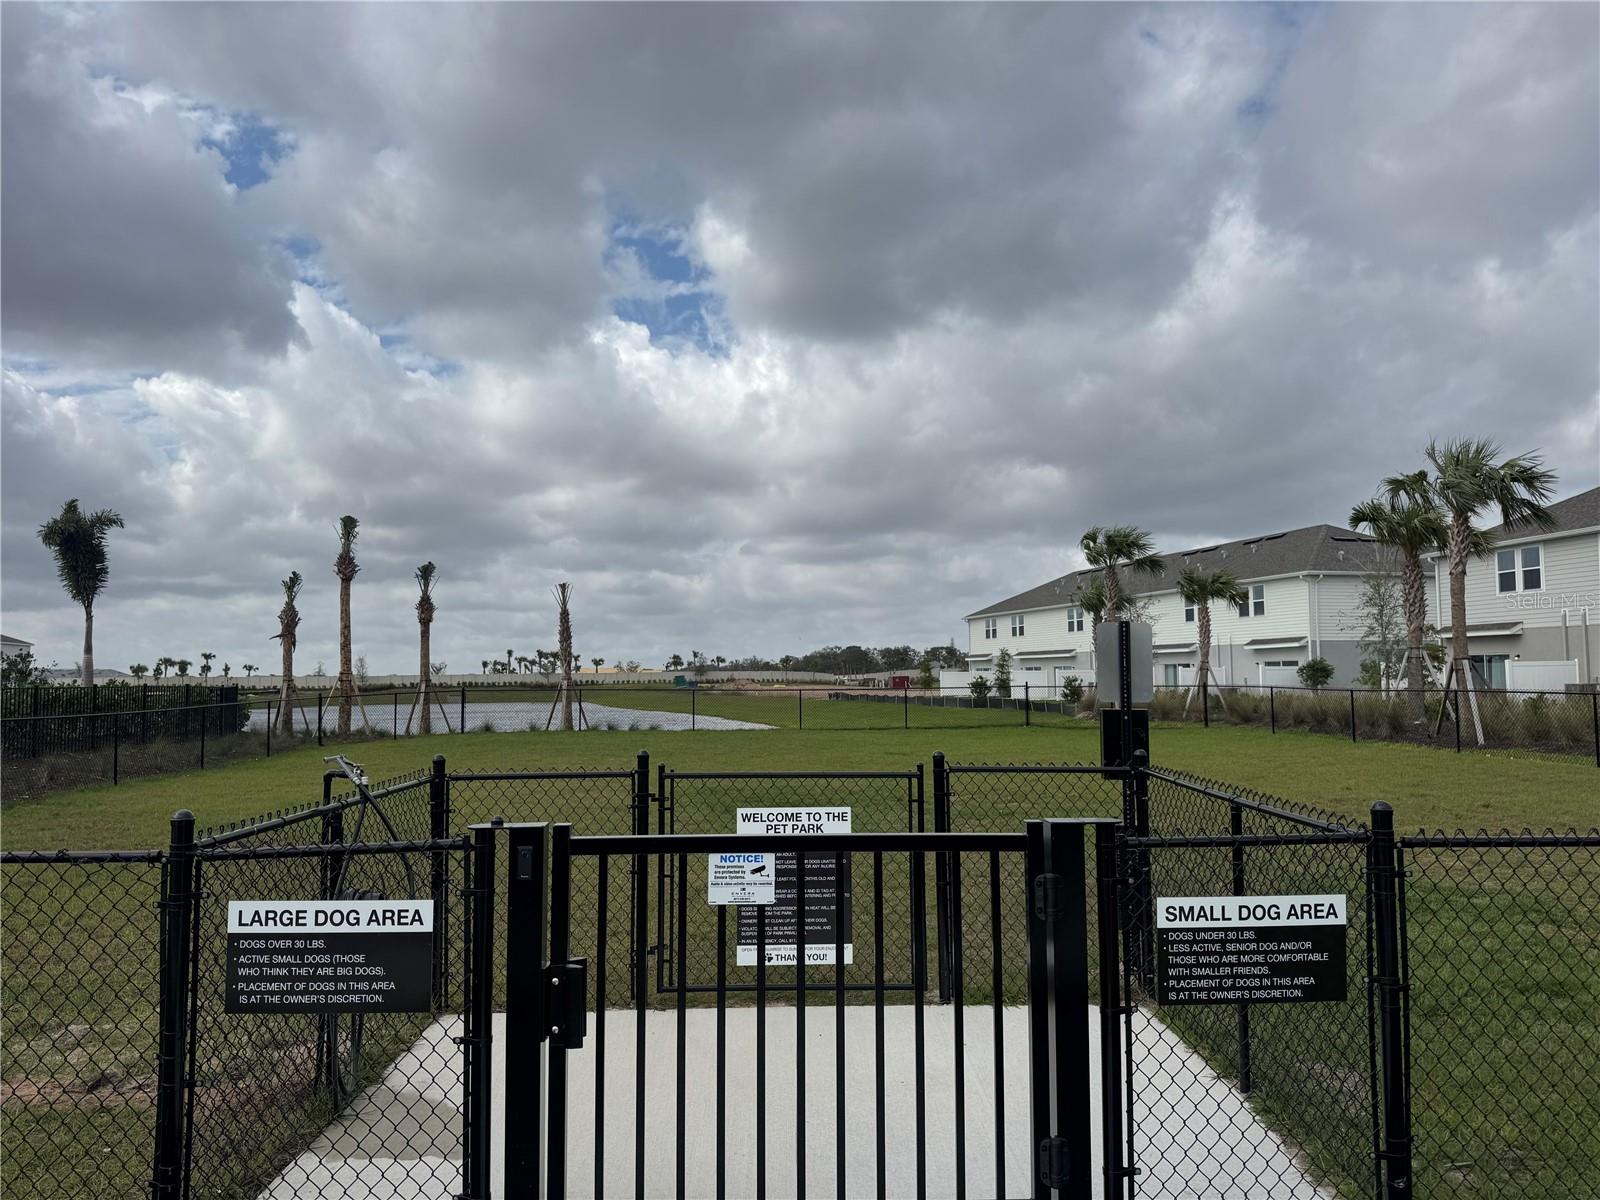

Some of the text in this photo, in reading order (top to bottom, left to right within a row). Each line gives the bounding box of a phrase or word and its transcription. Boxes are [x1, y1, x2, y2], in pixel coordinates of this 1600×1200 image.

[741, 812, 848, 823] WELCOME TO THE
[766, 824, 824, 834] PET PARK
[238, 909, 424, 926] LARGE DOG AREA
[1165, 903, 1338, 922] SMALL DOG AREA
[1169, 932, 1193, 940] DOGS
[1196, 932, 1225, 940] UNDER
[240, 940, 326, 948] DOGS OVER 30 LBS.
[1169, 944, 1189, 952] LESS
[1192, 944, 1223, 952] ACTIVE,
[1226, 943, 1257, 951] SENIOR
[1280, 942, 1312, 950] AND/OR
[239, 955, 365, 964] ACTIVE SMALL DOGS (THOSE
[1168, 956, 1197, 964] THOSE
[1222, 955, 1239, 963] ARE
[1267, 953, 1328, 962] COMFORTABLE
[238, 968, 260, 976] WHO
[262, 968, 288, 976] THINK
[292, 968, 314, 976] THEY
[337, 967, 352, 975] BIG
[355, 967, 386, 976] DOGS).
[1168, 967, 1271, 976] WITH SMALLER FRIENDS.
[238, 983, 292, 991] PLACEMENT
[309, 982, 335, 990] DOGS
[338, 982, 347, 990] IN
[349, 982, 369, 990] THIS
[371, 982, 395, 990] AREA
[1169, 977, 1315, 988] PLACEMENT OF DOGS IN THIS AREA
[240, 995, 384, 1003] IS AT THE OWNER'S DISCRETION.
[1169, 992, 1177, 1000] IS
[1178, 992, 1190, 1000] AT
[1210, 991, 1250, 999] OWNER'S
[1252, 990, 1303, 998] DISCRETION.
